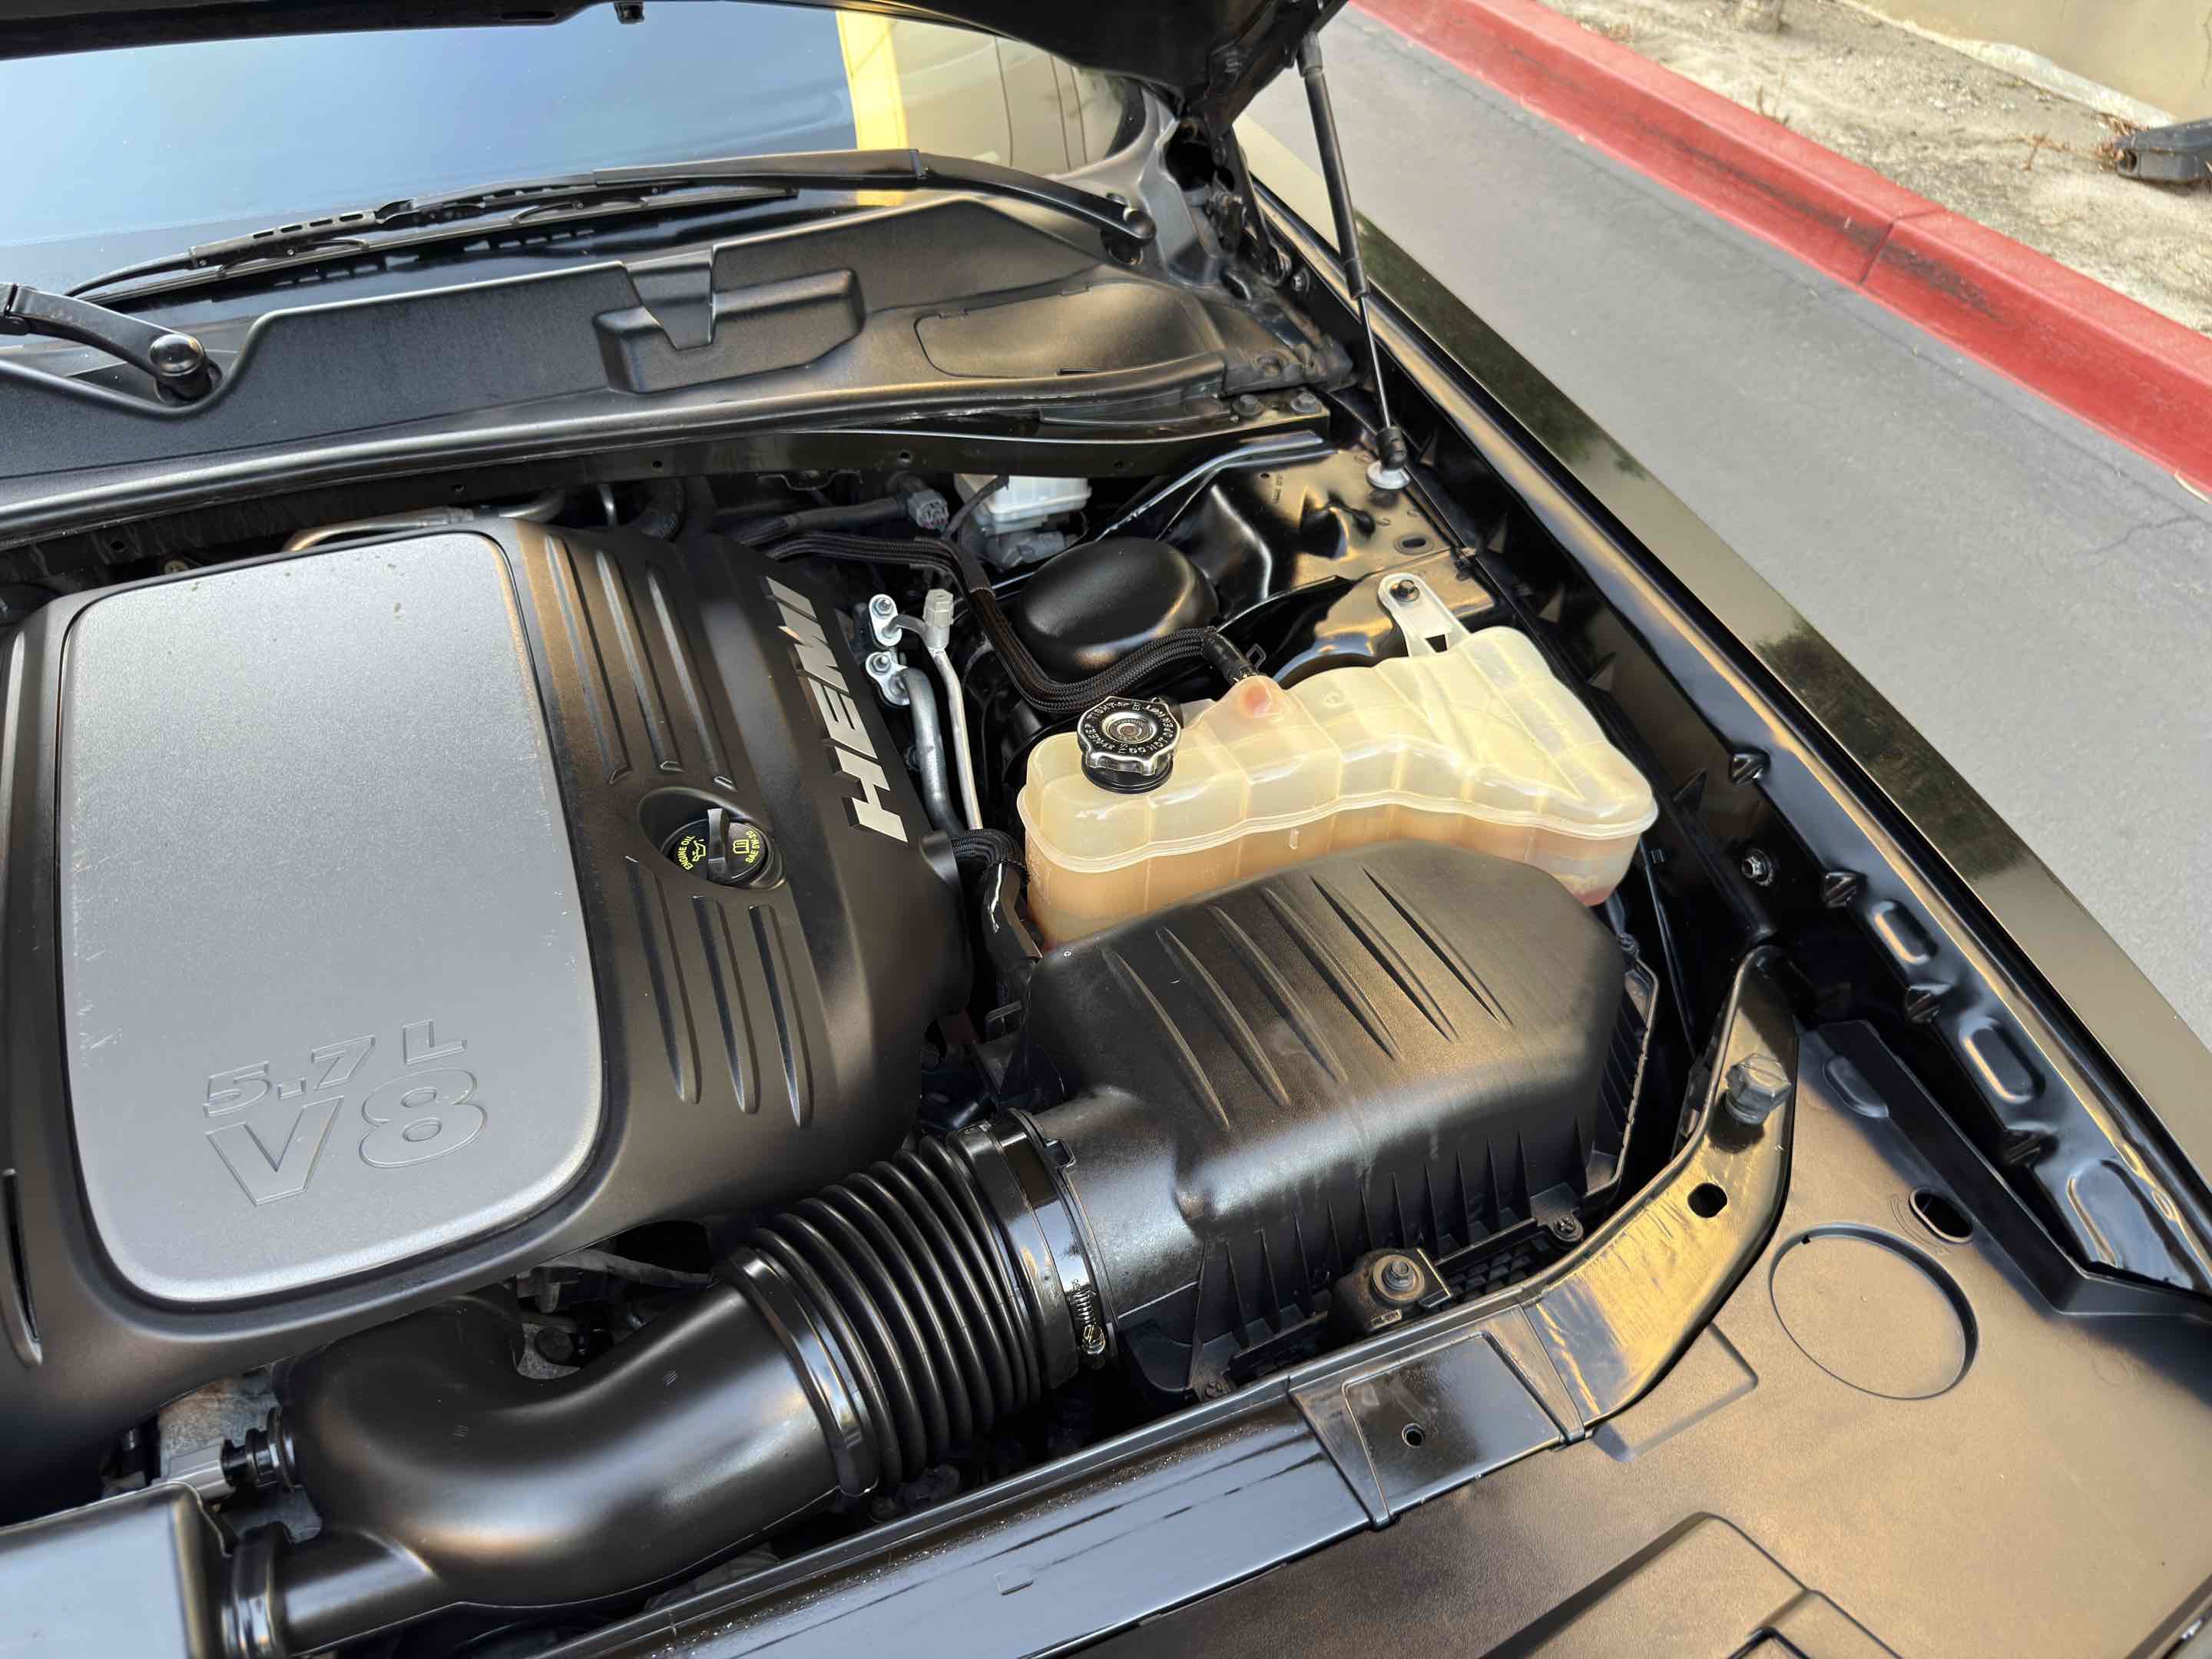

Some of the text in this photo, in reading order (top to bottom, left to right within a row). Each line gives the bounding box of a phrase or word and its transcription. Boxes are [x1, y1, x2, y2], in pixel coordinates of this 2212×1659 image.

[765, 575, 909, 843] HEMI
[677, 835, 696, 870] ENGINE OIL
[745, 849, 759, 863] SAE
[204, 1068, 488, 1206] V8
